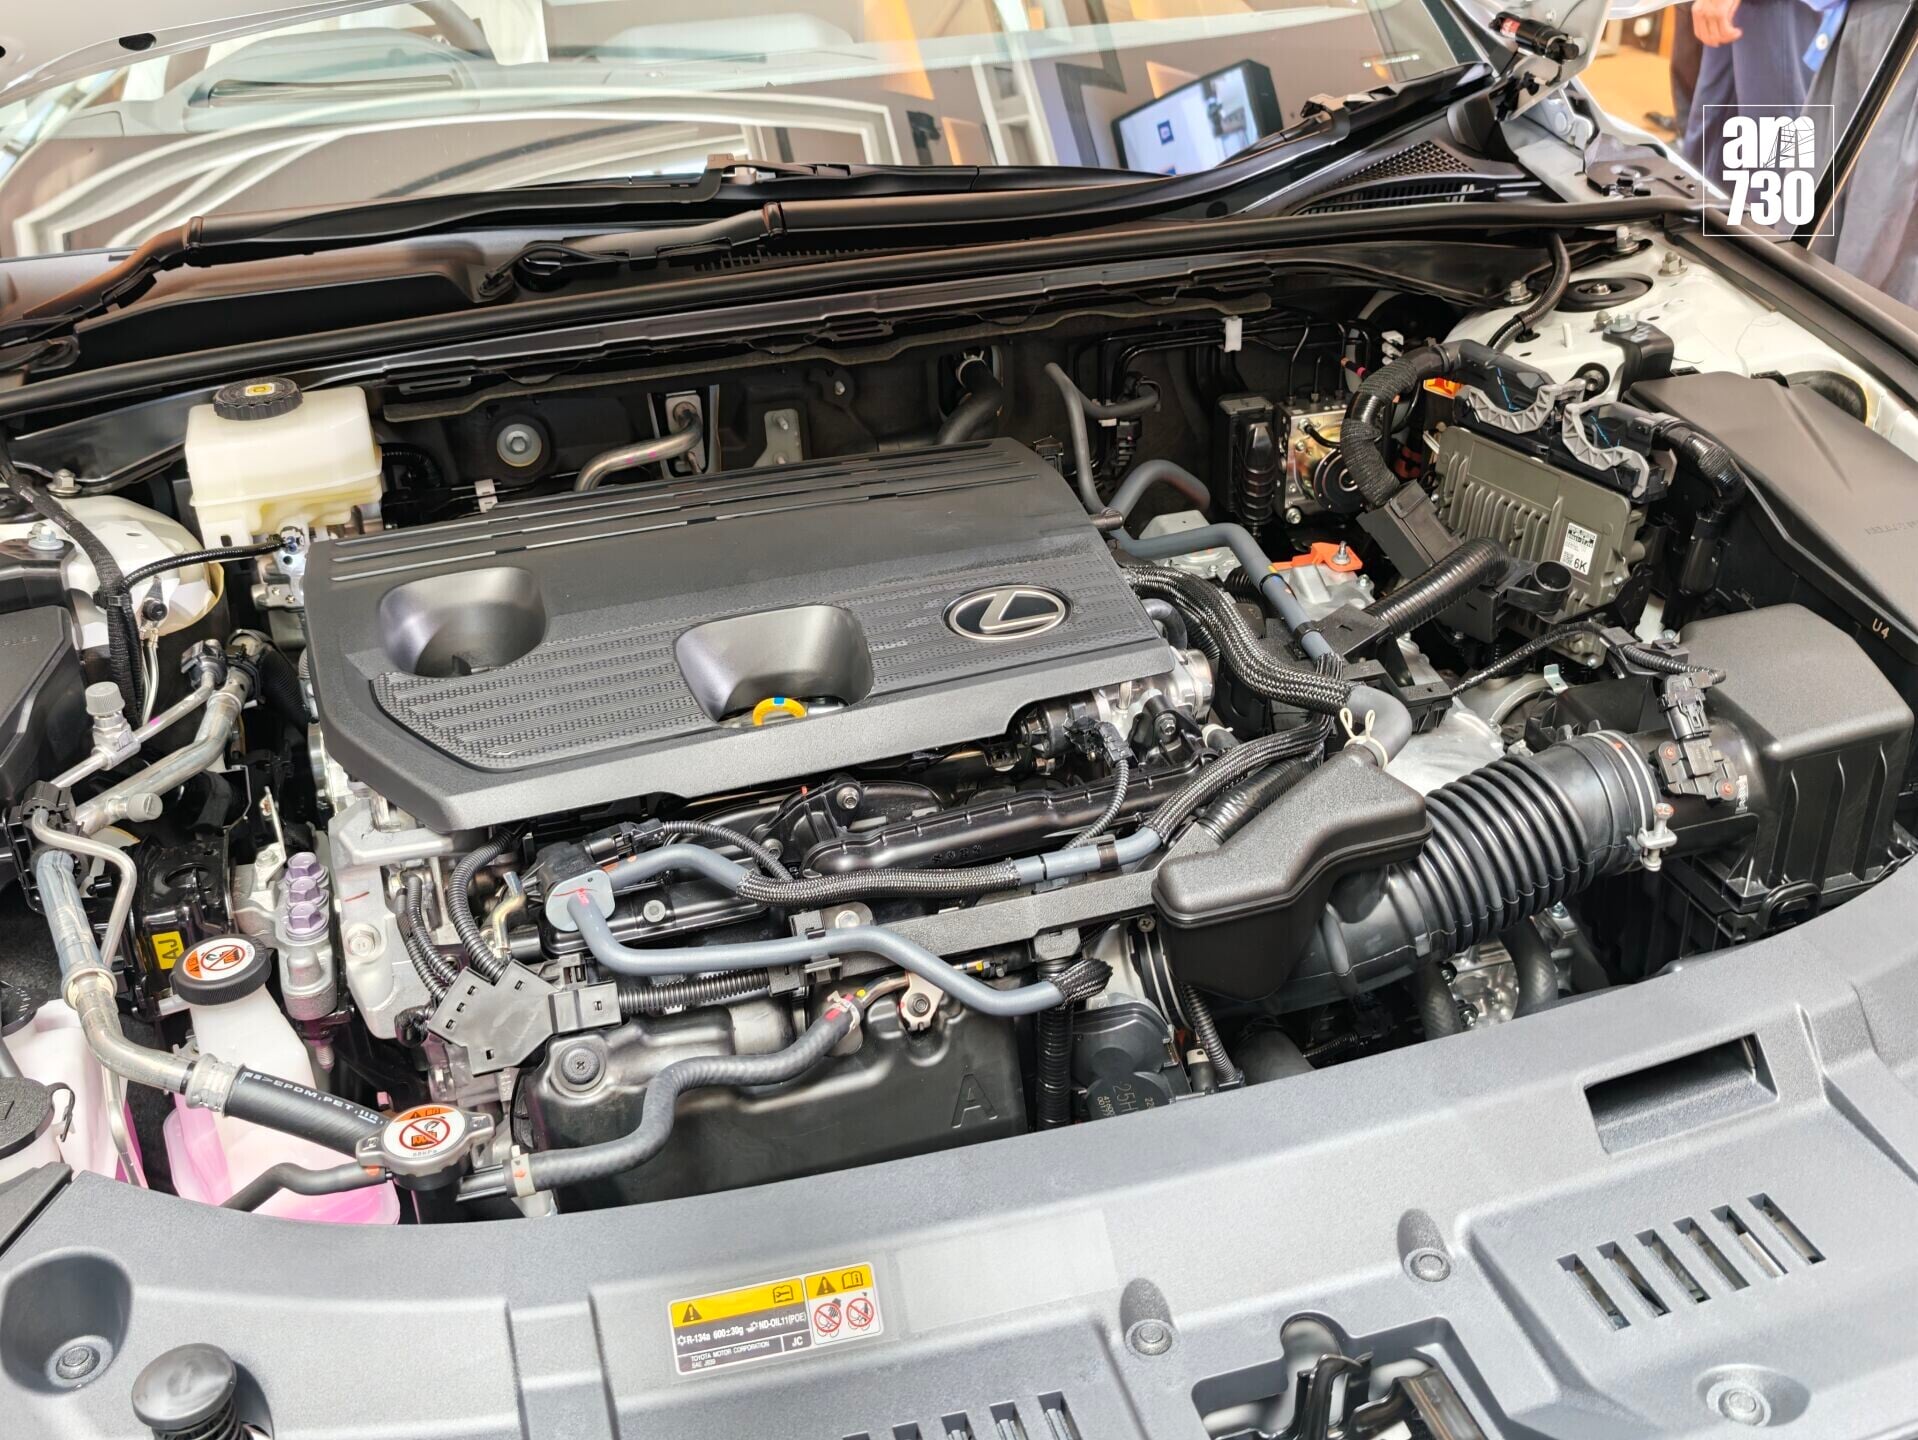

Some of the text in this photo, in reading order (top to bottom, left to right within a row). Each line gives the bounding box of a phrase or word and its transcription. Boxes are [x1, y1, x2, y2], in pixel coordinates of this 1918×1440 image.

[1574, 558, 1587, 573] 6K
[1872, 618, 1890, 639] U4
[158, 939, 179, 960] AJ
[951, 1073, 998, 1129] A
[686, 1312, 807, 1345] R-134a 600±30g ND-OIL11(POE)
[691, 1341, 770, 1363] TOYOTA MOTOR CORPORATION
[792, 1335, 804, 1348] JC
